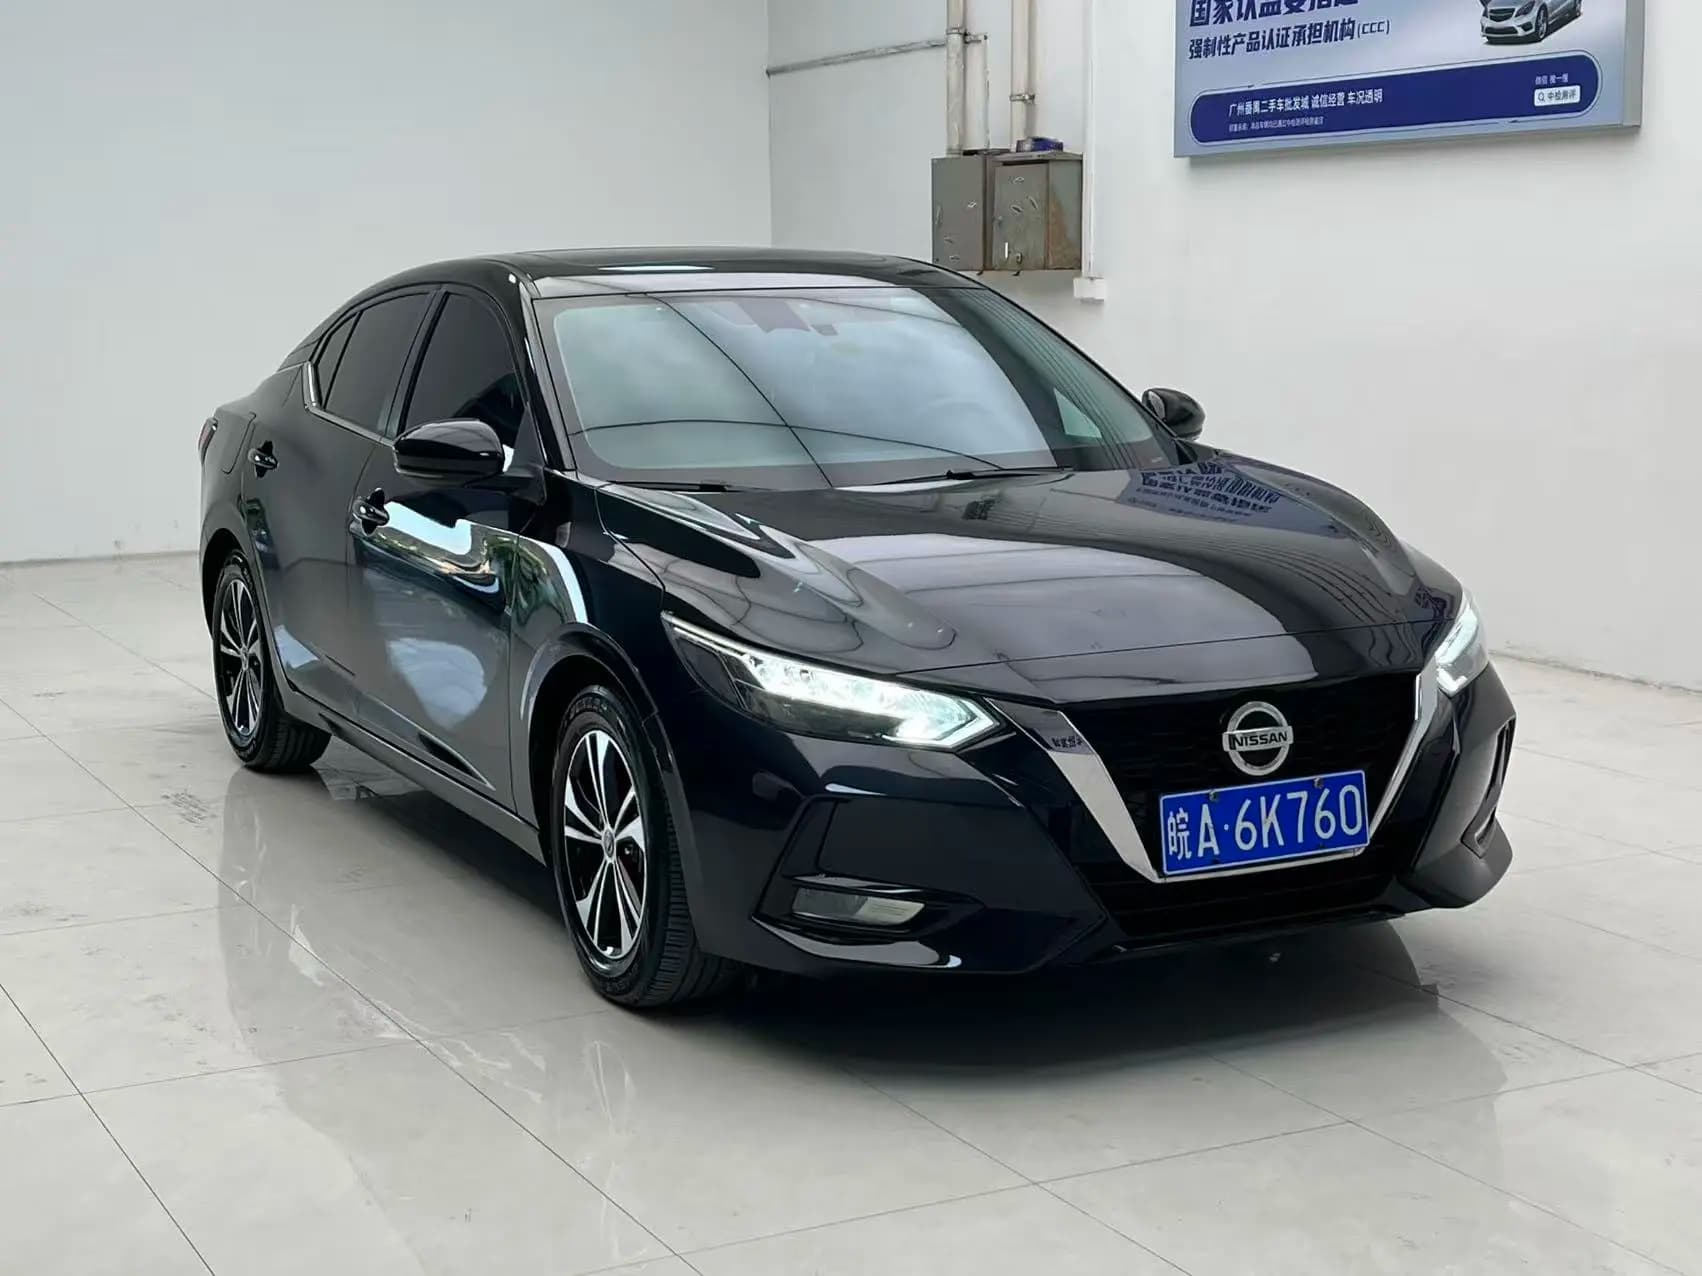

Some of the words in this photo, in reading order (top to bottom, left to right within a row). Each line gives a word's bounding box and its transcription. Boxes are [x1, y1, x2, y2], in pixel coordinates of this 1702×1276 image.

[1189, 0, 1359, 27] 国家认监委
[1228, 731, 1288, 750] NISSAN
